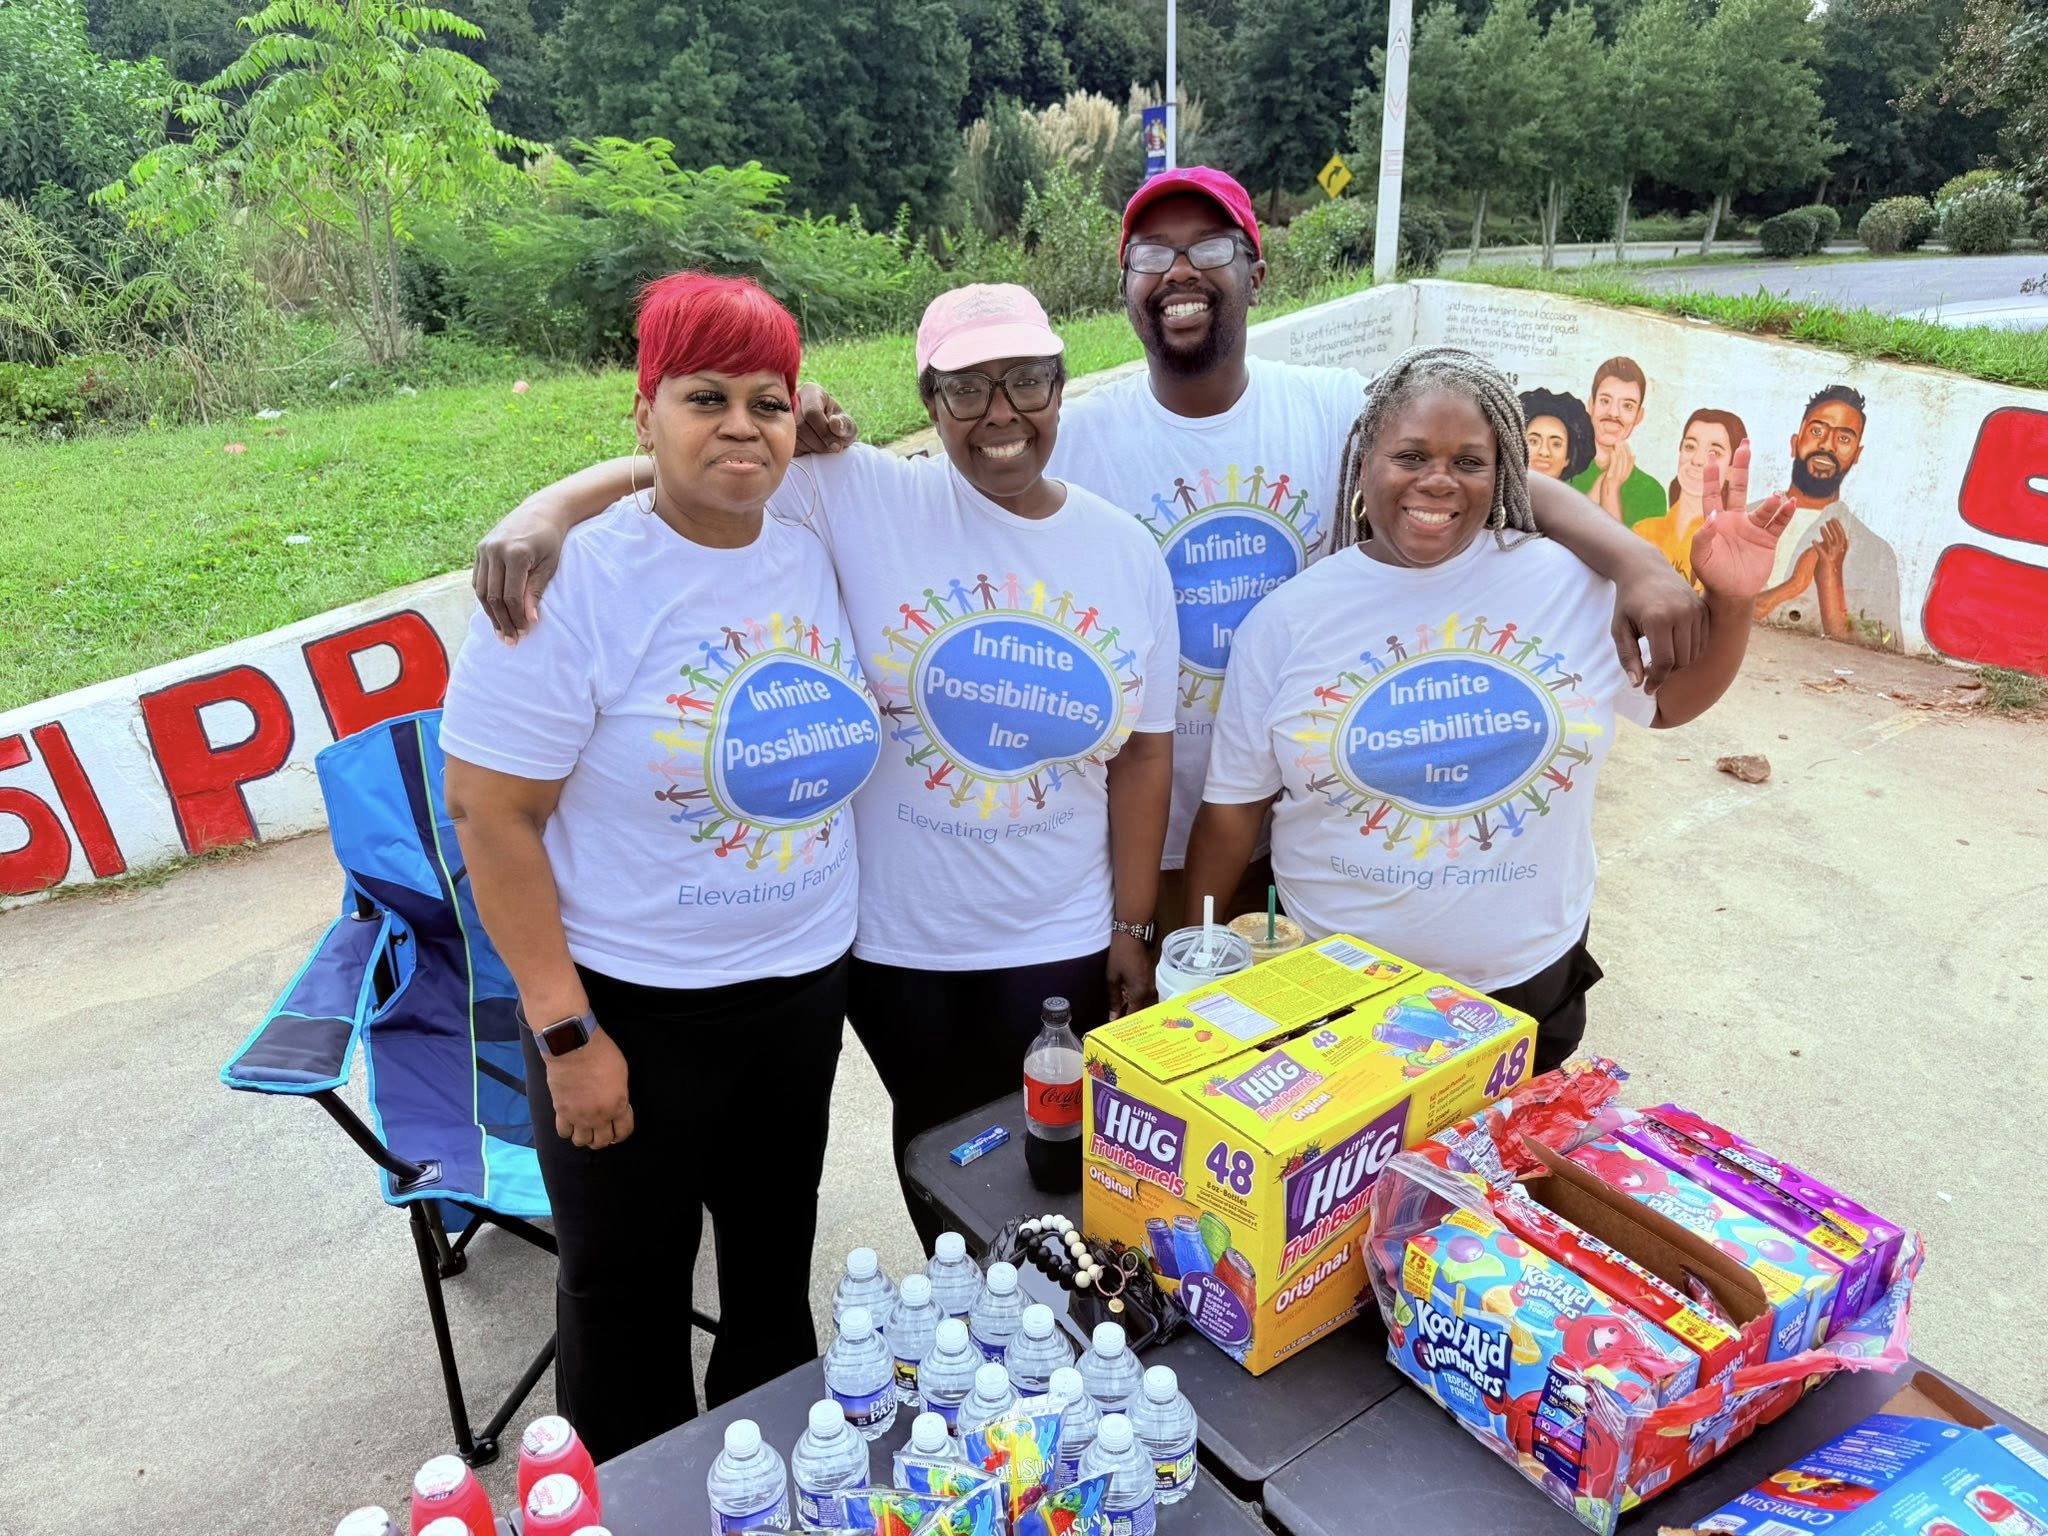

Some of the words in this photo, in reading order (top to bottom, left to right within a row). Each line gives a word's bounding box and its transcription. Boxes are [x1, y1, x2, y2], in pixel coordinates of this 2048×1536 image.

[1184, 530, 1266, 564] Infinite
[1175, 573, 1288, 605] ossibilities
[973, 629, 1074, 672] Infinite
[1213, 622, 1234, 648] In
[748, 678, 832, 712] Infinite
[927, 666, 1104, 731] Possibilities,
[1390, 673, 1490, 706] Infinite
[725, 717, 880, 771] Possibilities,
[988, 722, 1030, 748] Inc
[1350, 708, 1542, 754] Possibilities,
[1425, 763, 1469, 783] Inc
[788, 777, 830, 803] Inc
[897, 803, 998, 844] Elevating
[1005, 806, 1075, 839] Families
[1331, 856, 1433, 890] Elevating
[1443, 863, 1538, 885] Families
[678, 880, 796, 907] Elevating
[1311, 1029, 1339, 1050] 48
[1239, 1059, 1300, 1105] HUG
[1253, 1064, 1272, 1078] Little
[1483, 1035, 1530, 1100] 48
[1132, 1106, 1158, 1124] Little
[1290, 1091, 1332, 1121] Original
[1103, 1097, 1178, 1162] HUG
[1344, 1128, 1377, 1158] Little
[1089, 1167, 1134, 1200] Original
[1205, 1140, 1254, 1196] 48
[1301, 1123, 1399, 1229] HUG
[1202, 1277, 1226, 1296] Only
[1275, 1243, 1350, 1315] Original
[1521, 1265, 1591, 1311] Kool-Aid
[1187, 1284, 1202, 1315] 1
[1517, 1286, 1581, 1320] Jammers
[1415, 1298, 1510, 1372] Kool-Aid
[1423, 1341, 1503, 1398] Jammers
[1443, 1372, 1478, 1398] TROPICAL
[1664, 1366, 1696, 1397] TROPICAL
[1450, 1384, 1476, 1405] PUNCH
[1540, 1421, 1551, 1432] 10
[1800, 1465, 1833, 1477] GAME
[1833, 1470, 1848, 1479] IN
[1850, 1474, 1875, 1485] FILL
